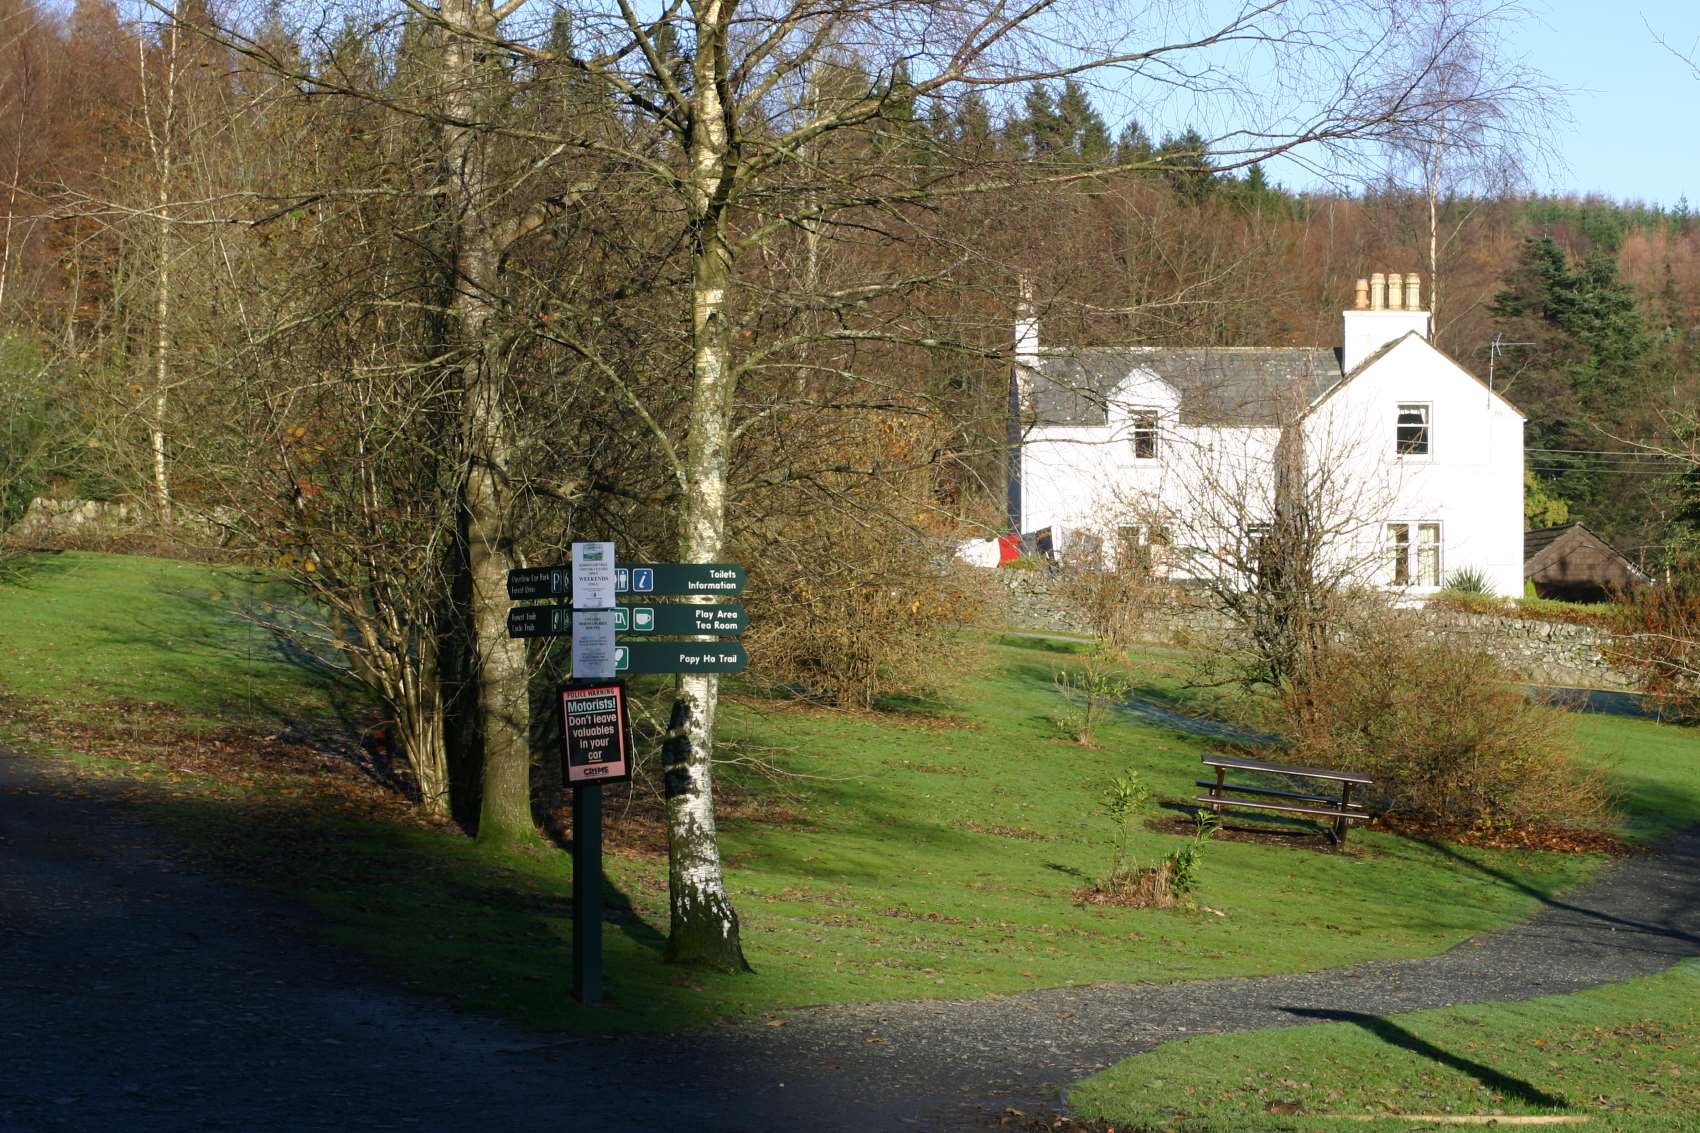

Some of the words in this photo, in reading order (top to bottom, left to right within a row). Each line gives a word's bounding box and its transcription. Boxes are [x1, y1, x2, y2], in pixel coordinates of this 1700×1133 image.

[710, 570, 736, 578] Toilets
[688, 581, 736, 590] Information
[696, 610, 714, 620] Play
[717, 610, 738, 618] Area
[696, 620, 712, 630] Tea
[714, 621, 738, 630] Room
[719, 654, 736, 663] Trail
[568, 698, 616, 712] Motorists!
[569, 714, 592, 726] Don't
[594, 714, 616, 724] leave
[573, 725, 614, 738] valuables
[580, 740, 588, 748] in
[590, 738, 609, 750] your
[588, 751, 602, 760] car
